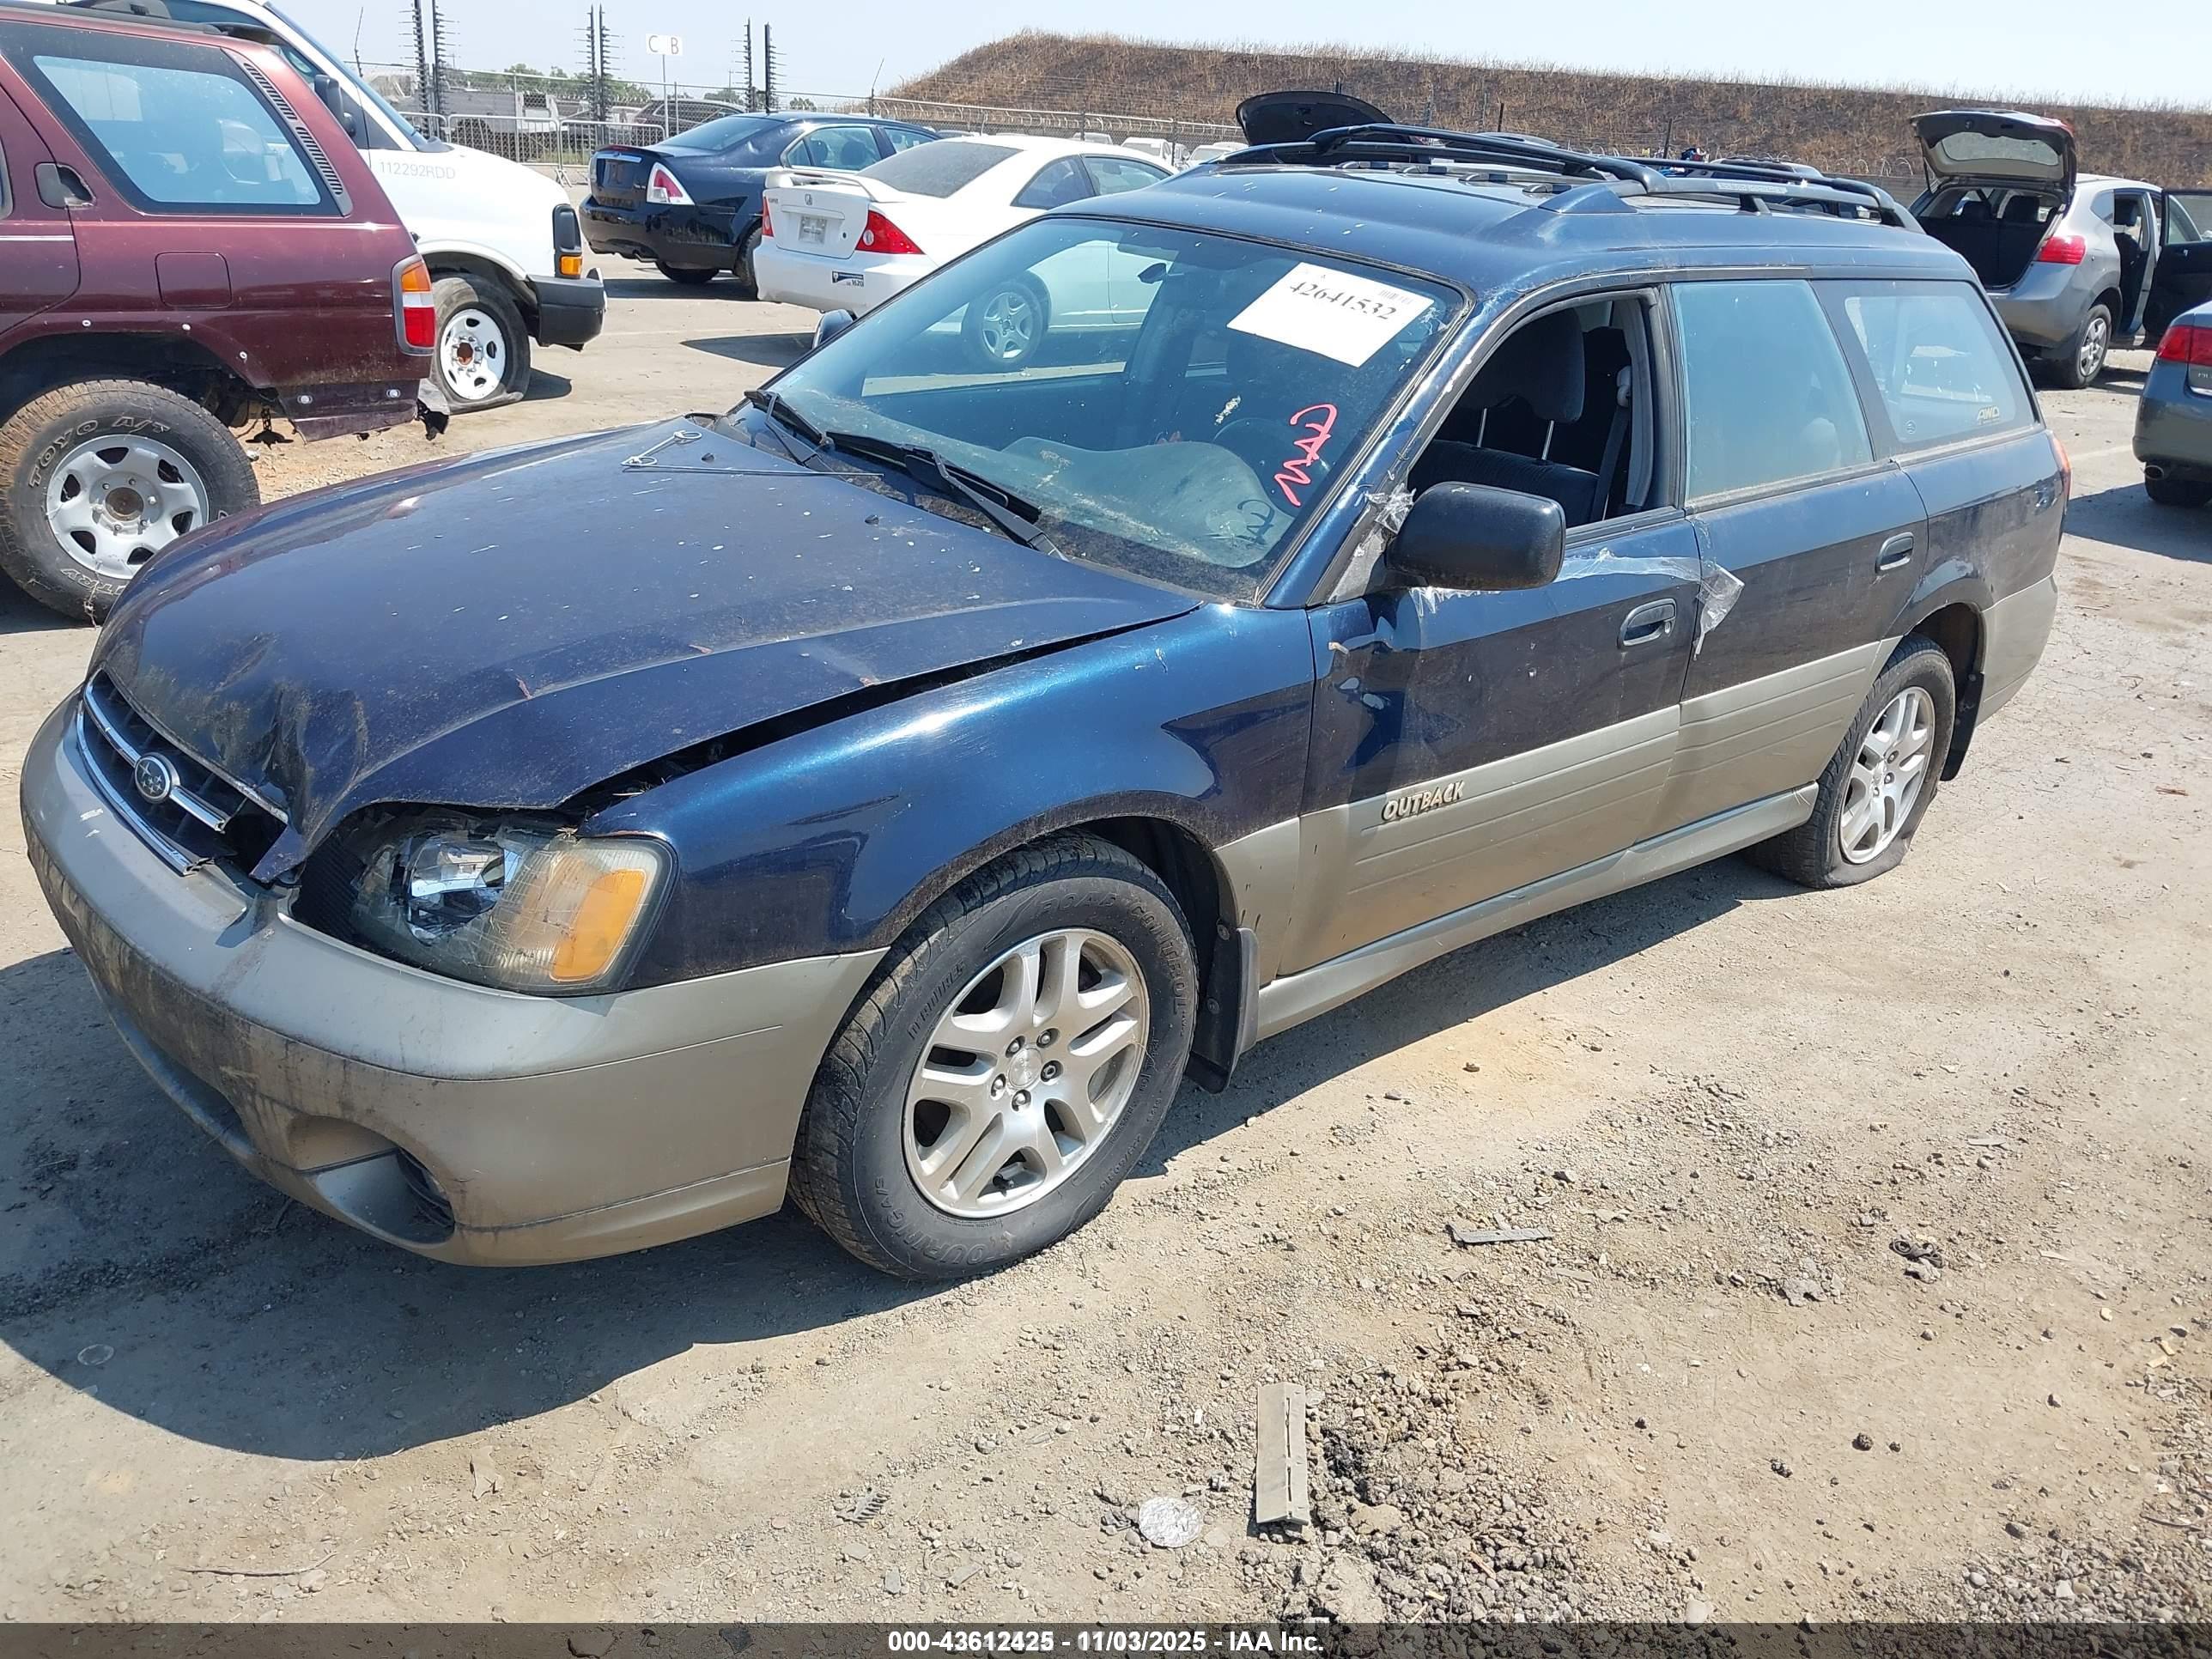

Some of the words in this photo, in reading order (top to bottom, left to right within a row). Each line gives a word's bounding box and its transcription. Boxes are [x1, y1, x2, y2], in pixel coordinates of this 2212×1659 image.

[648, 35, 659, 52] C
[671, 37, 679, 55] B
[1289, 281, 1397, 320] 42641532
[1978, 405, 2000, 421] AWD
[29, 419, 99, 488] TOYO
[1381, 781, 1465, 822] OUTBACK
